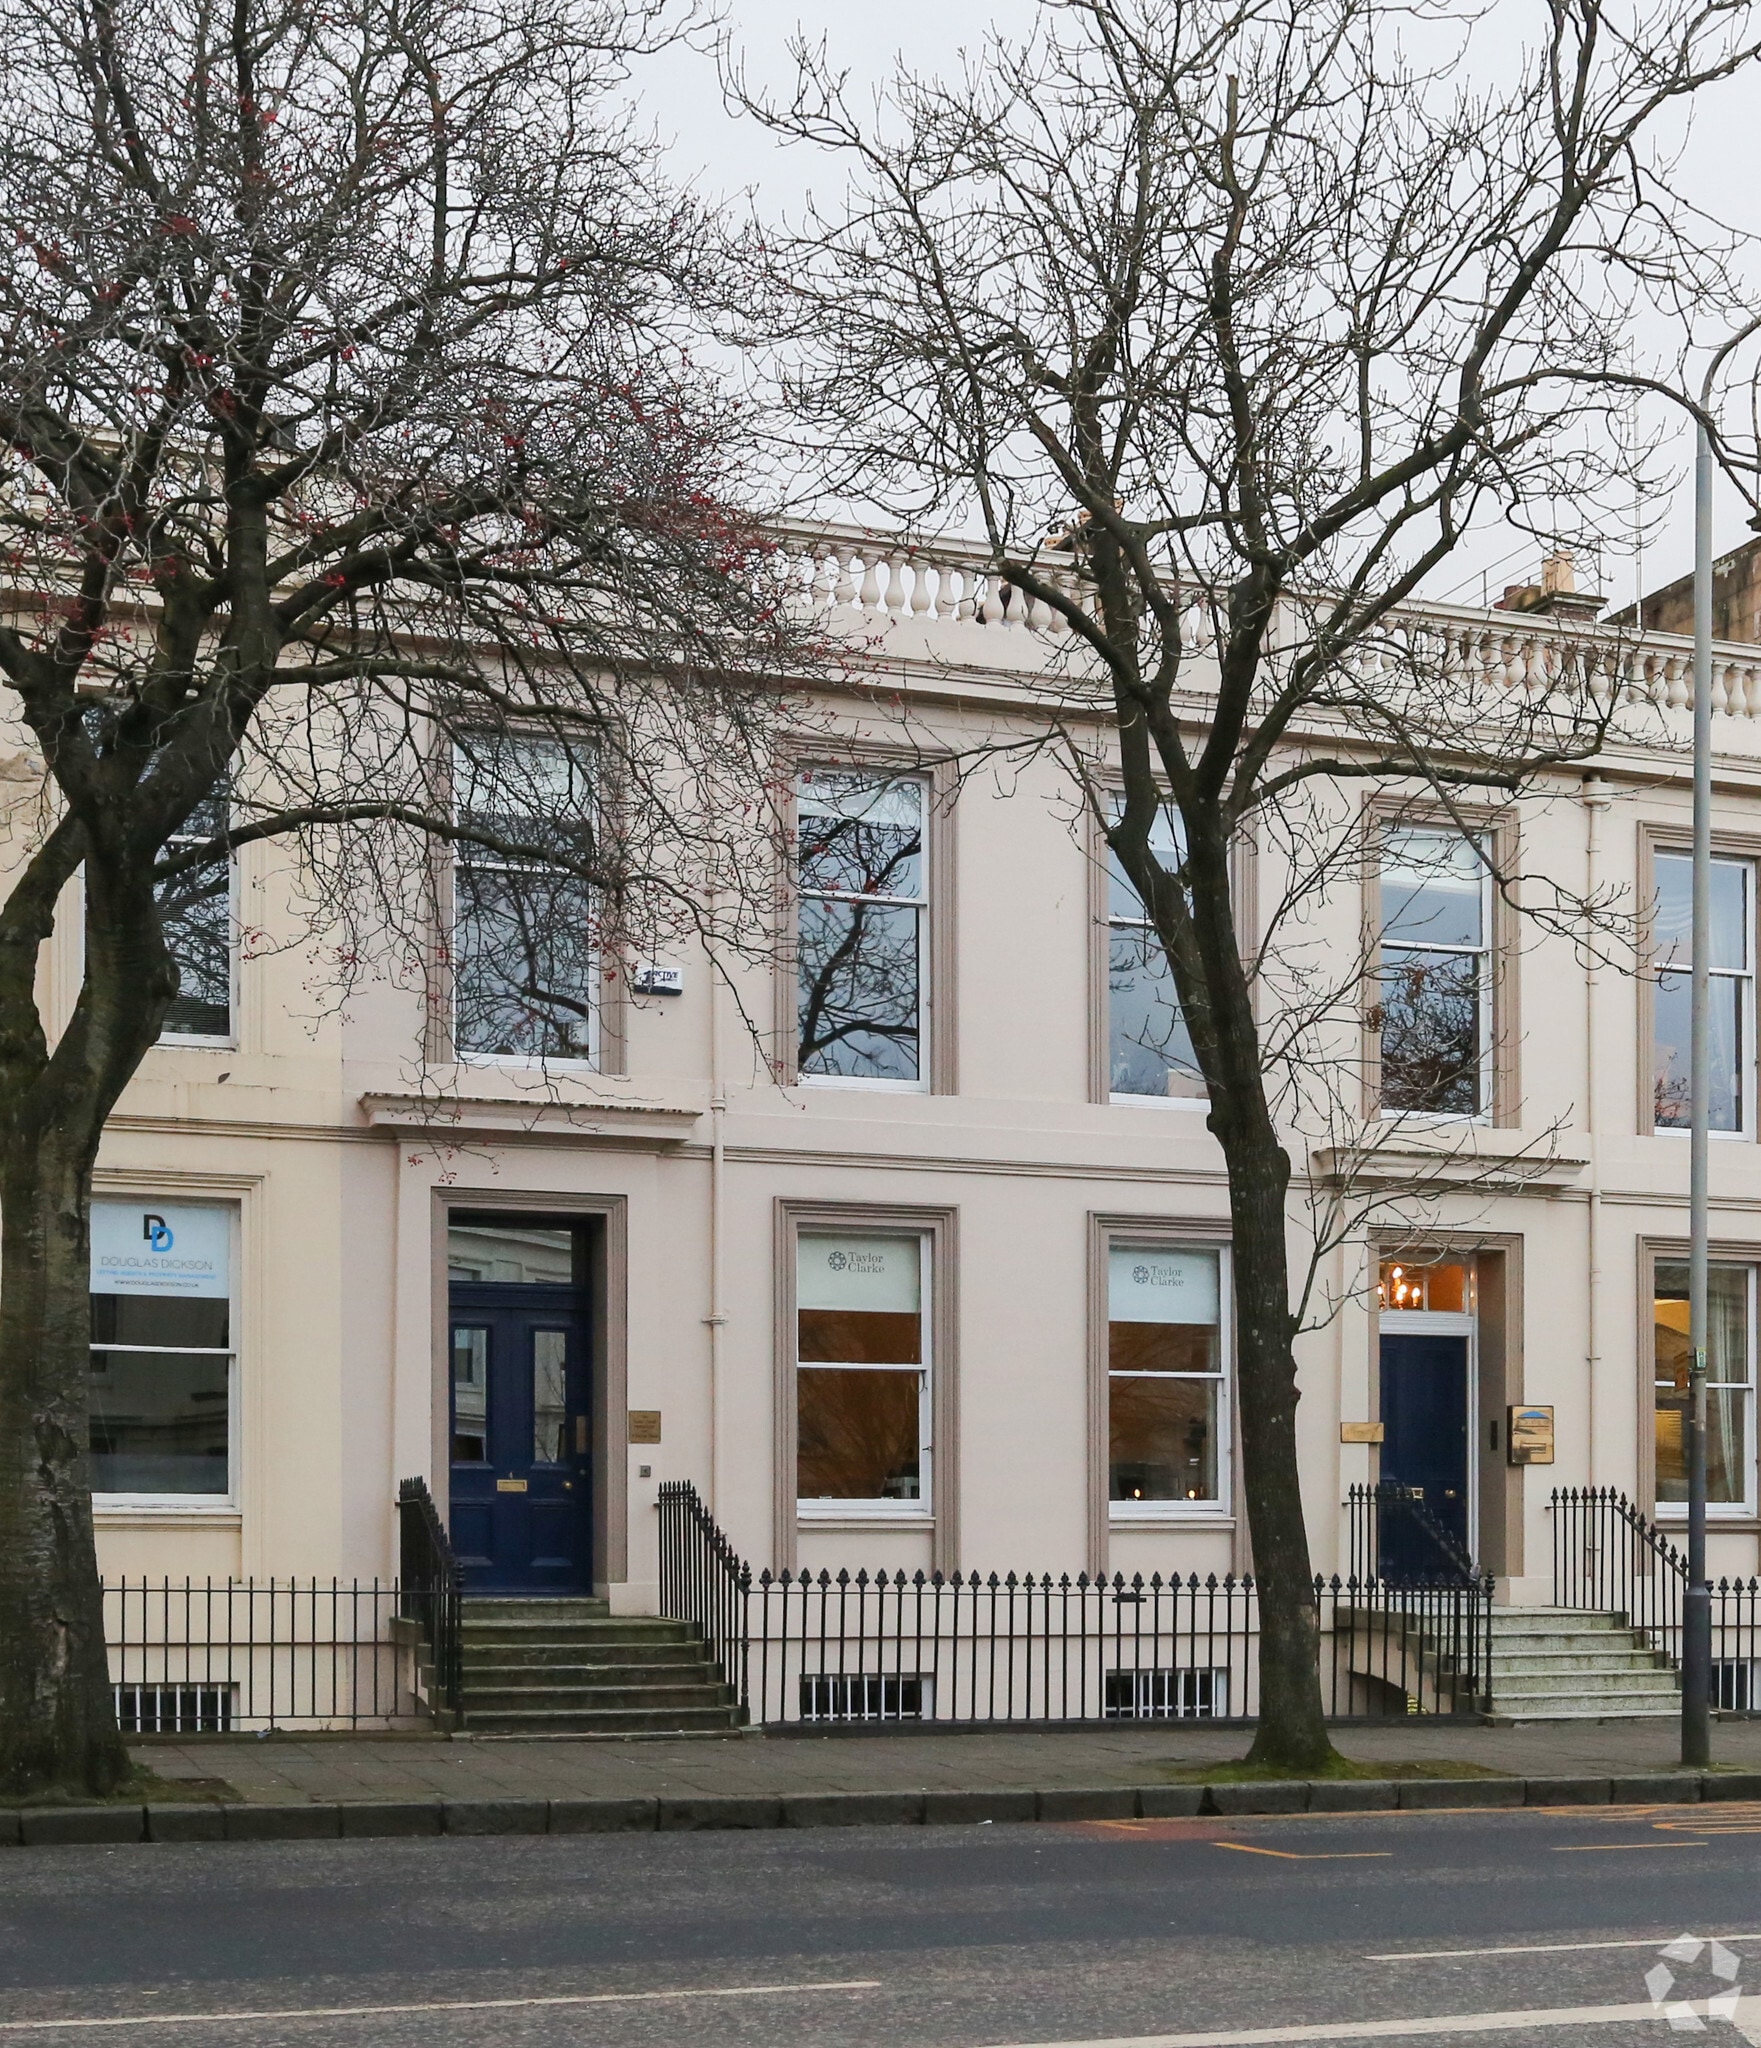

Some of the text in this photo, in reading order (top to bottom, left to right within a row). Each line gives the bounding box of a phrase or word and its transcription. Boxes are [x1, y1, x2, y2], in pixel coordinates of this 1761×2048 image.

[101, 1256, 213, 1271] DOUGLAS DICKSON
[848, 1251, 883, 1264] Taylor
[848, 1262, 885, 1273] Clarke
[1151, 1265, 1182, 1278] Taylor
[1151, 1276, 1184, 1287] Clarke
